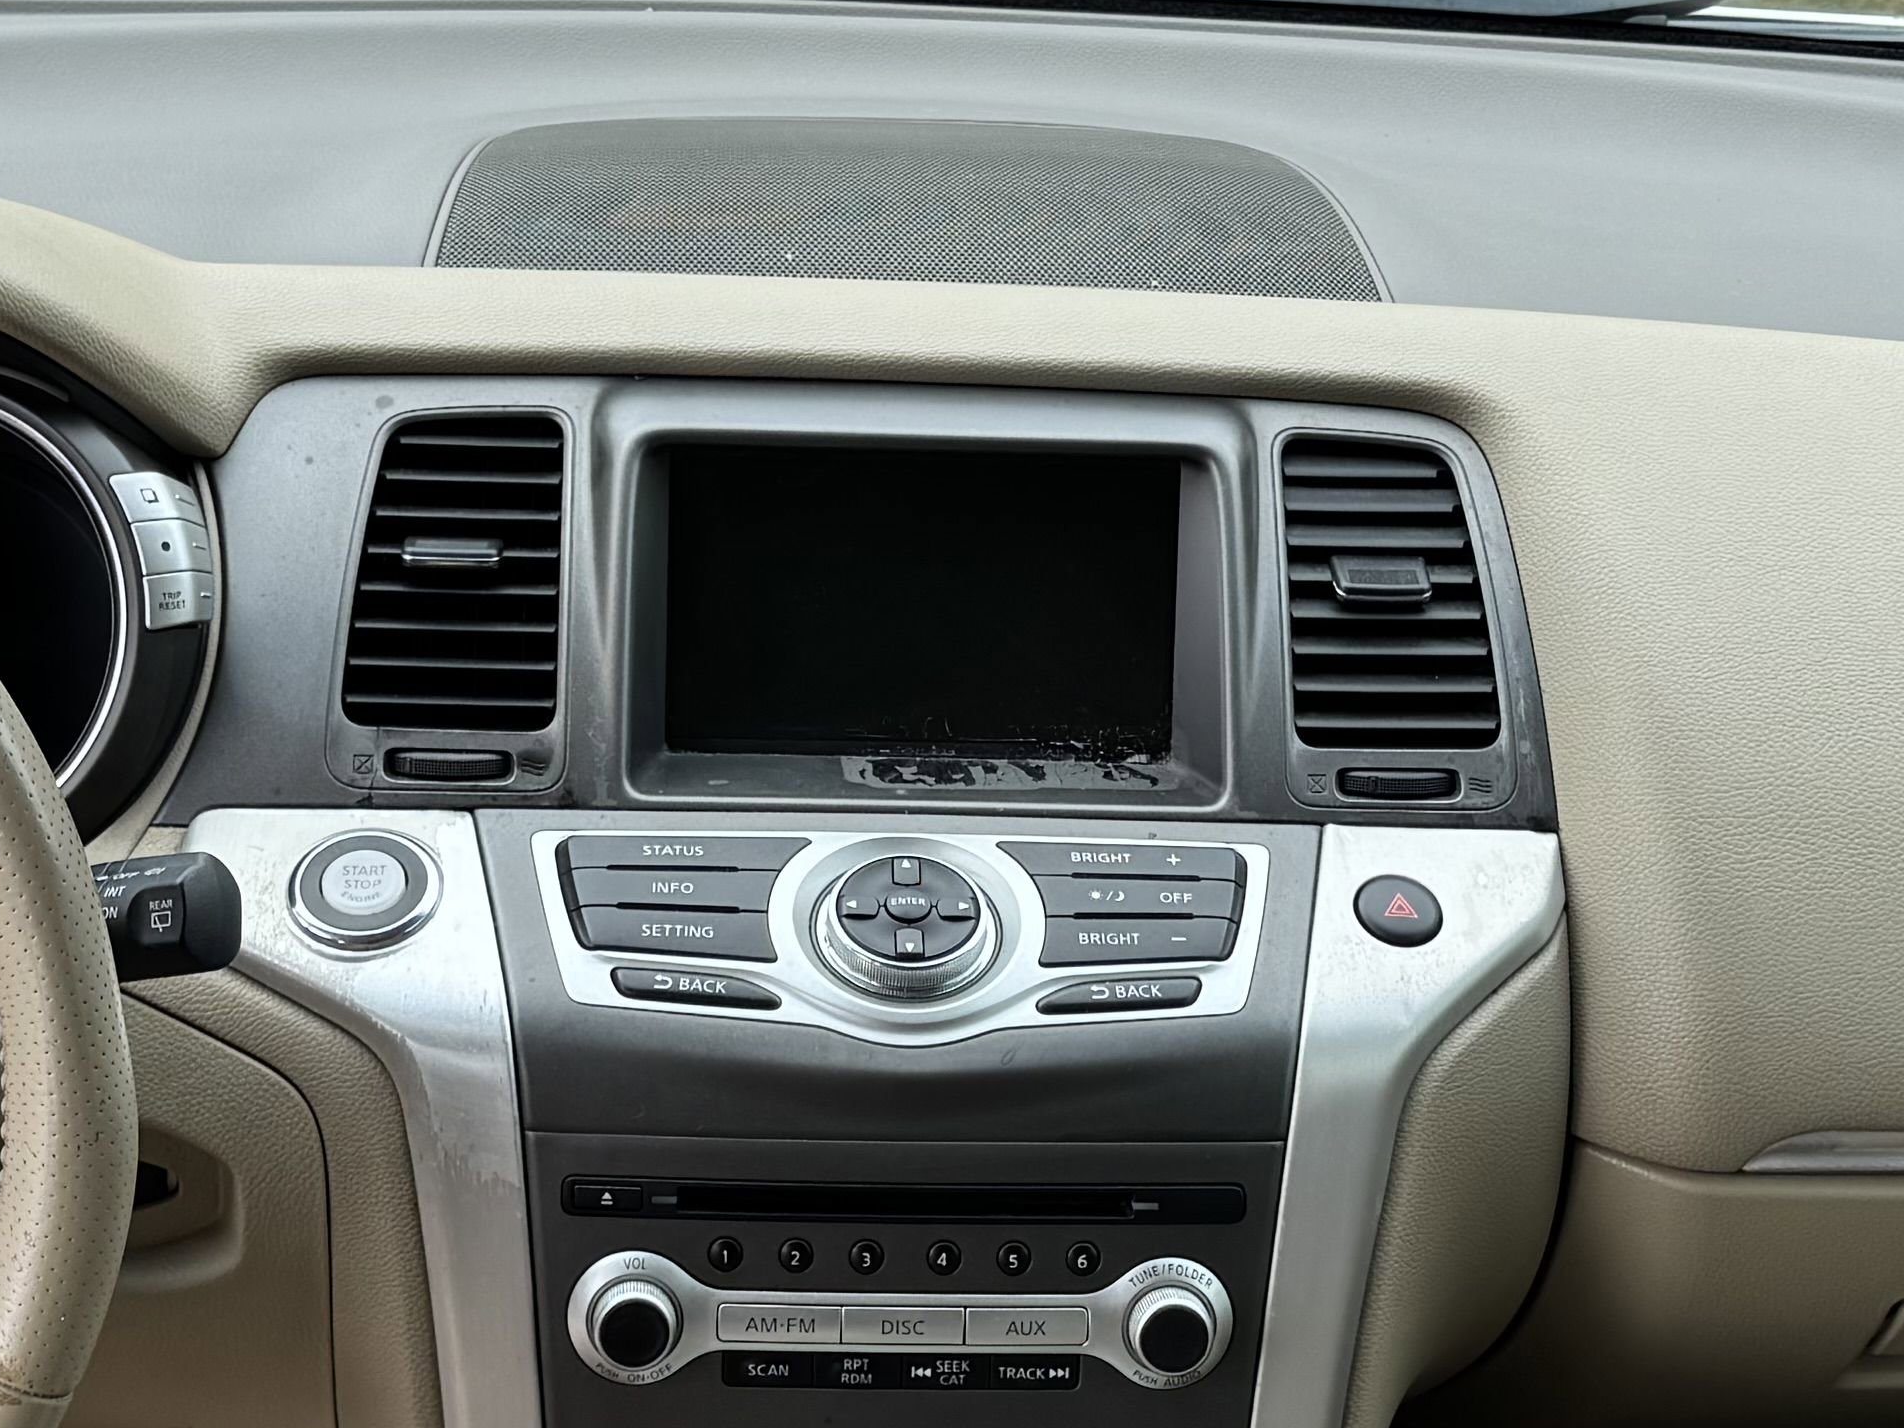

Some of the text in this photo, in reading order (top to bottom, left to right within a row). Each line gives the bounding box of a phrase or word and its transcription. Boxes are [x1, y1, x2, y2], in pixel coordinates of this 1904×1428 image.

[162, 591, 182, 601] TRIP
[158, 600, 186, 611] RESET
[642, 844, 704, 857] STATUS
[1070, 851, 1132, 864] BRIGHT
[342, 864, 387, 876] START
[344, 879, 382, 889] STOP
[652, 882, 694, 894] INFO
[103, 885, 126, 898] INT
[1159, 892, 1194, 904] OFF
[149, 899, 173, 911] REAR
[890, 897, 927, 907] ENTER
[641, 924, 714, 938] SETTING
[1078, 932, 1141, 945] BRIGHT
[679, 978, 727, 994] BACK
[1114, 984, 1162, 999] BACK
[623, 1257, 647, 1271] VOL
[791, 1252, 800, 1265] 2
[861, 1253, 871, 1266] 3
[937, 1253, 947, 1266] 4
[1009, 1255, 1019, 1269] 5
[1077, 1255, 1088, 1269] 6
[1128, 1263, 1213, 1289] TUNE/FOLDER
[881, 1320, 926, 1335] DISC
[1005, 1320, 1046, 1336] AUX
[747, 1364, 789, 1377] SCAN
[843, 1359, 869, 1371] RPT
[936, 1359, 970, 1373] SEEK
[841, 1372, 872, 1385] RDM
[940, 1373, 967, 1386] CAT
[998, 1366, 1045, 1380] TRACK
[1163, 1370, 1201, 1387] AUDIO
